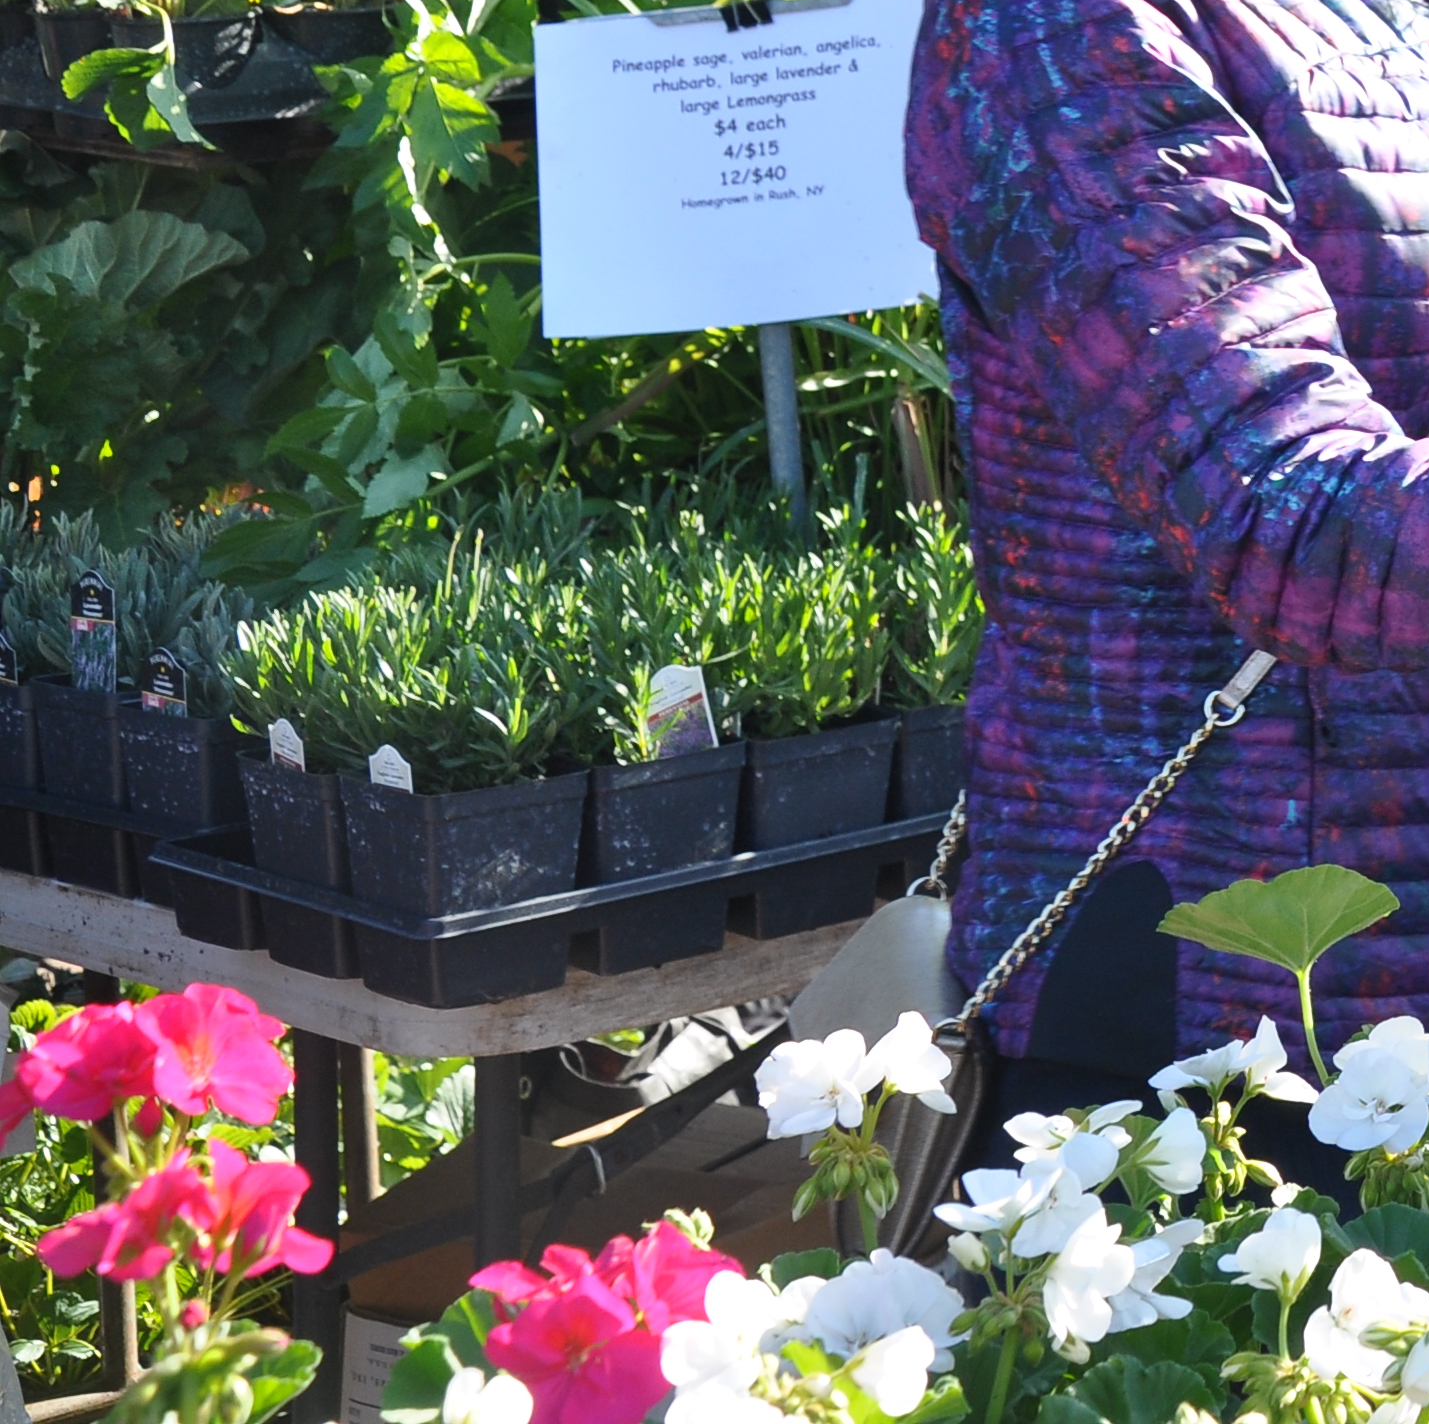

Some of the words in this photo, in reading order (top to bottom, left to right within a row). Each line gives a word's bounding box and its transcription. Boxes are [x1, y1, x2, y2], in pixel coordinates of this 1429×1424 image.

[612, 55, 685, 73] Pineapple
[693, 53, 733, 68] sage,
[741, 45, 807, 60] valerian,
[816, 35, 881, 55] angelica,
[653, 75, 721, 92] rhubarb,
[730, 71, 768, 87] large
[775, 62, 841, 80] lavender
[848, 58, 858, 72] &
[680, 99, 719, 115] large
[727, 90, 816, 109] Lemongrass
[714, 118, 737, 136] $4
[746, 114, 786, 132] each
[724, 140, 779, 159] 4/$15
[720, 165, 786, 186] 12/$40
[681, 195, 748, 208] Homegrown
[754, 192, 764, 201] in
[806, 185, 824, 196] NY
